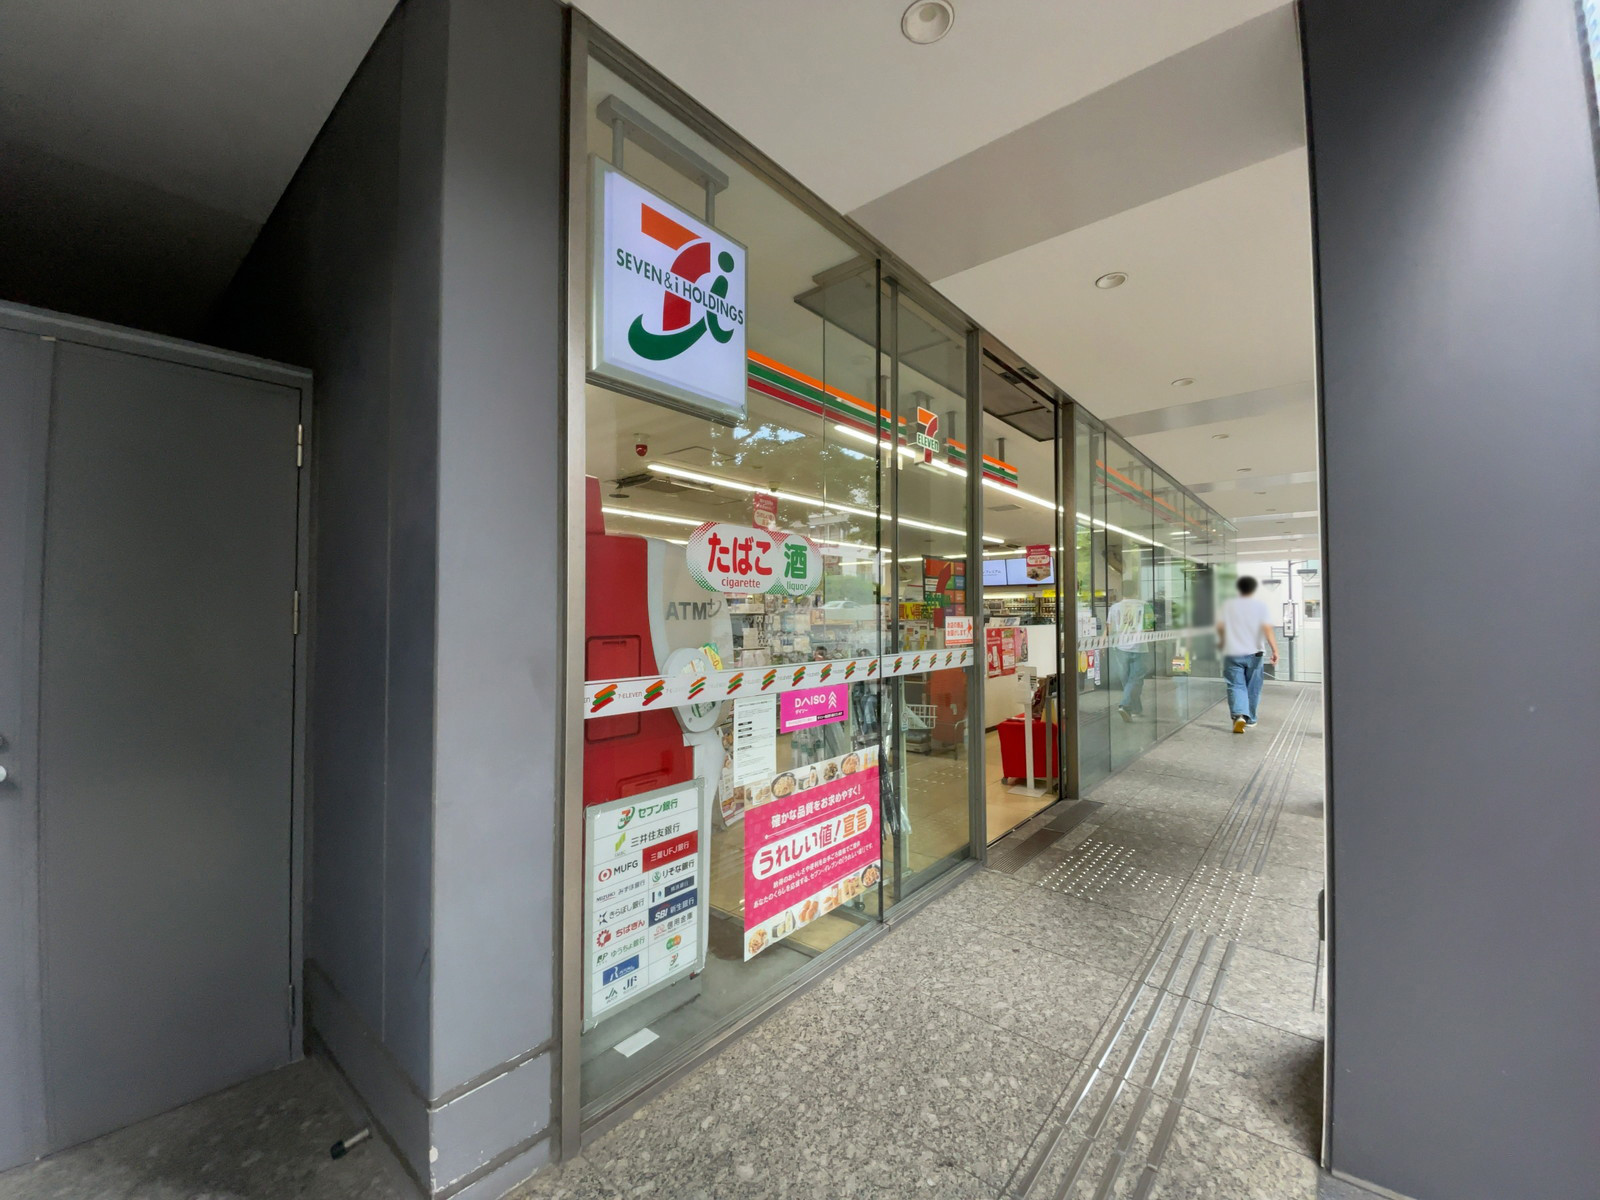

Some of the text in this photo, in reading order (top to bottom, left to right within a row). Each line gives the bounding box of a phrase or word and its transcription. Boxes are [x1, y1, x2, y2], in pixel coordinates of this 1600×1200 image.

[683, 284, 744, 325] HOLDINGS
[708, 532, 807, 579] たばこ 酒
[722, 577, 808, 592] cigarette liquor
[794, 694, 826, 708] DAISO
[638, 798, 678, 819] セブン銀行
[630, 822, 680, 848] 三井住友銀行
[650, 841, 690, 862] 三菱UFJ銀行
[613, 860, 639, 876] MUFG
[662, 859, 695, 878] りそな銀行
[609, 898, 645, 920] きらぼし銀行
[654, 909, 669, 922] SBI
